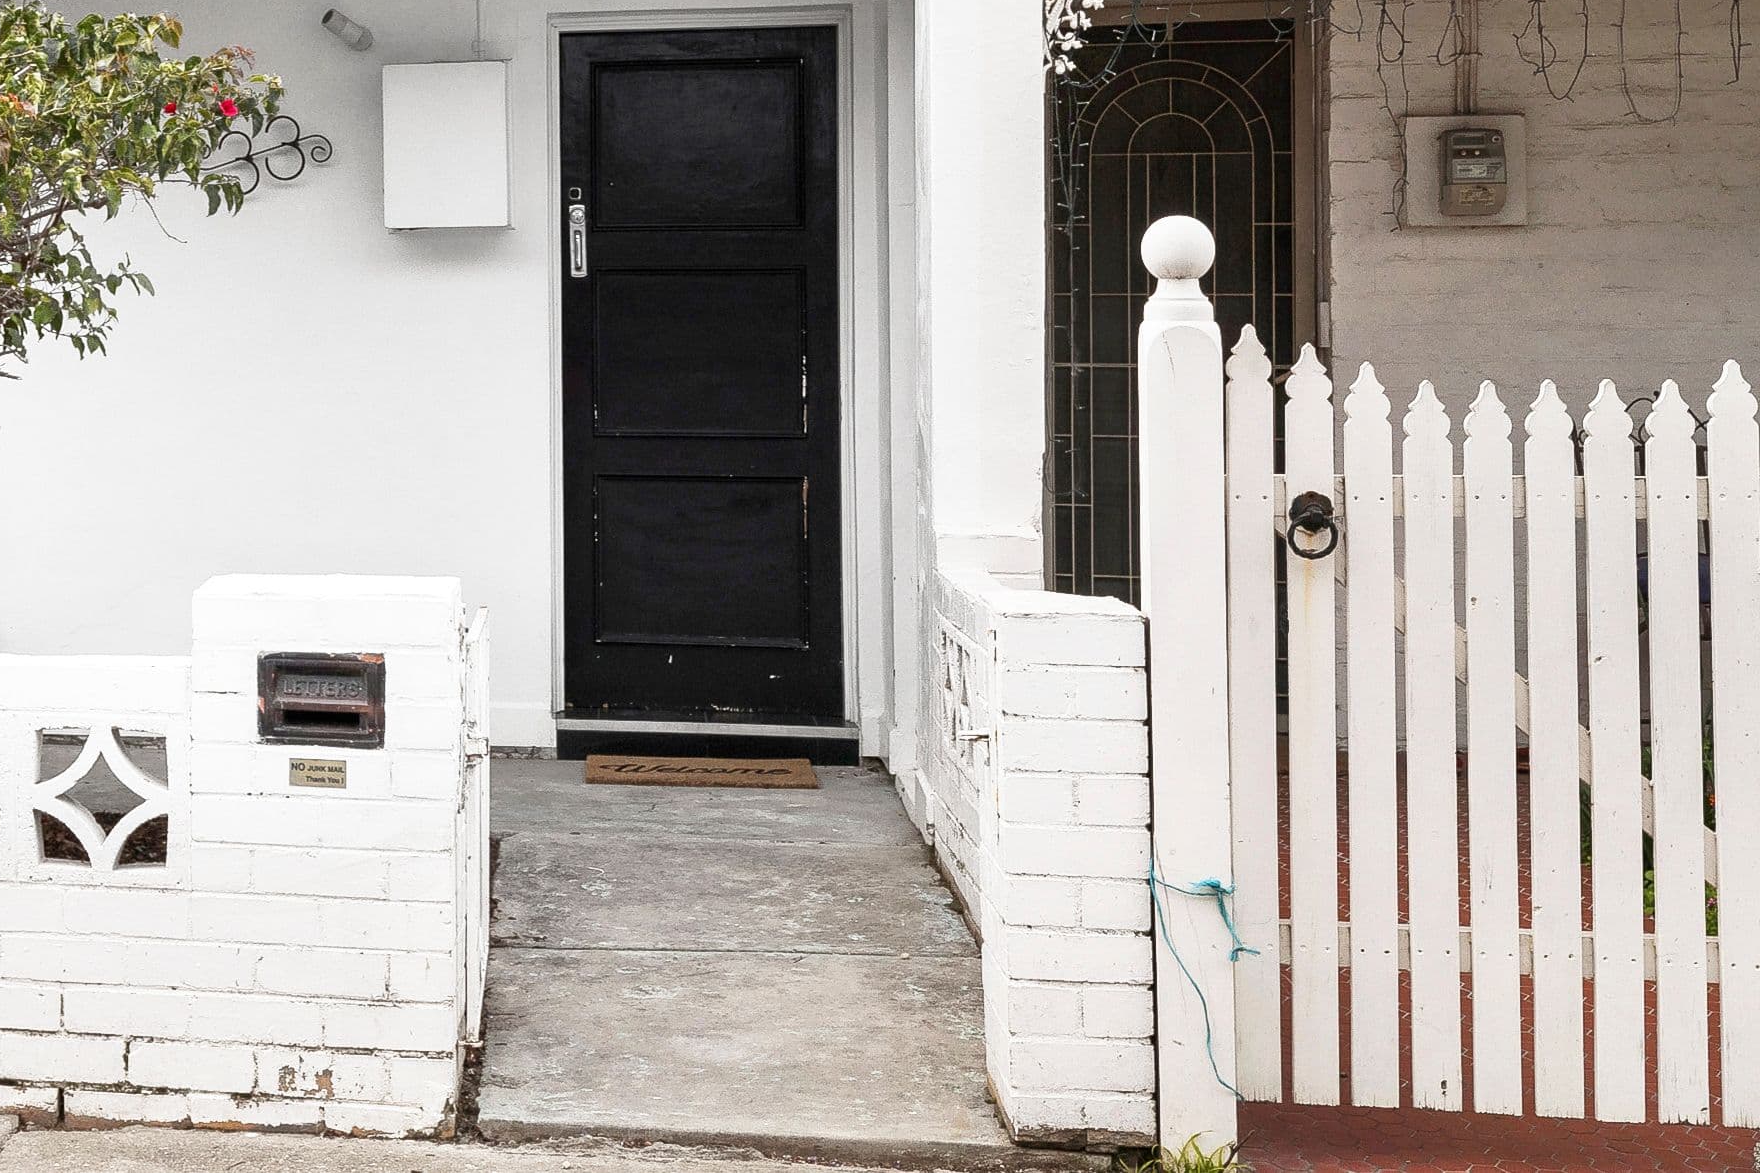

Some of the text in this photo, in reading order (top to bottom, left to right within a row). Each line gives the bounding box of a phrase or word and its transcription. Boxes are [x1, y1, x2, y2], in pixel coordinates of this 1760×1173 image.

[282, 679, 359, 697] LETTERS
[291, 762, 306, 772] NO
[599, 763, 792, 775] Welcome
[306, 775, 326, 783] Thank
